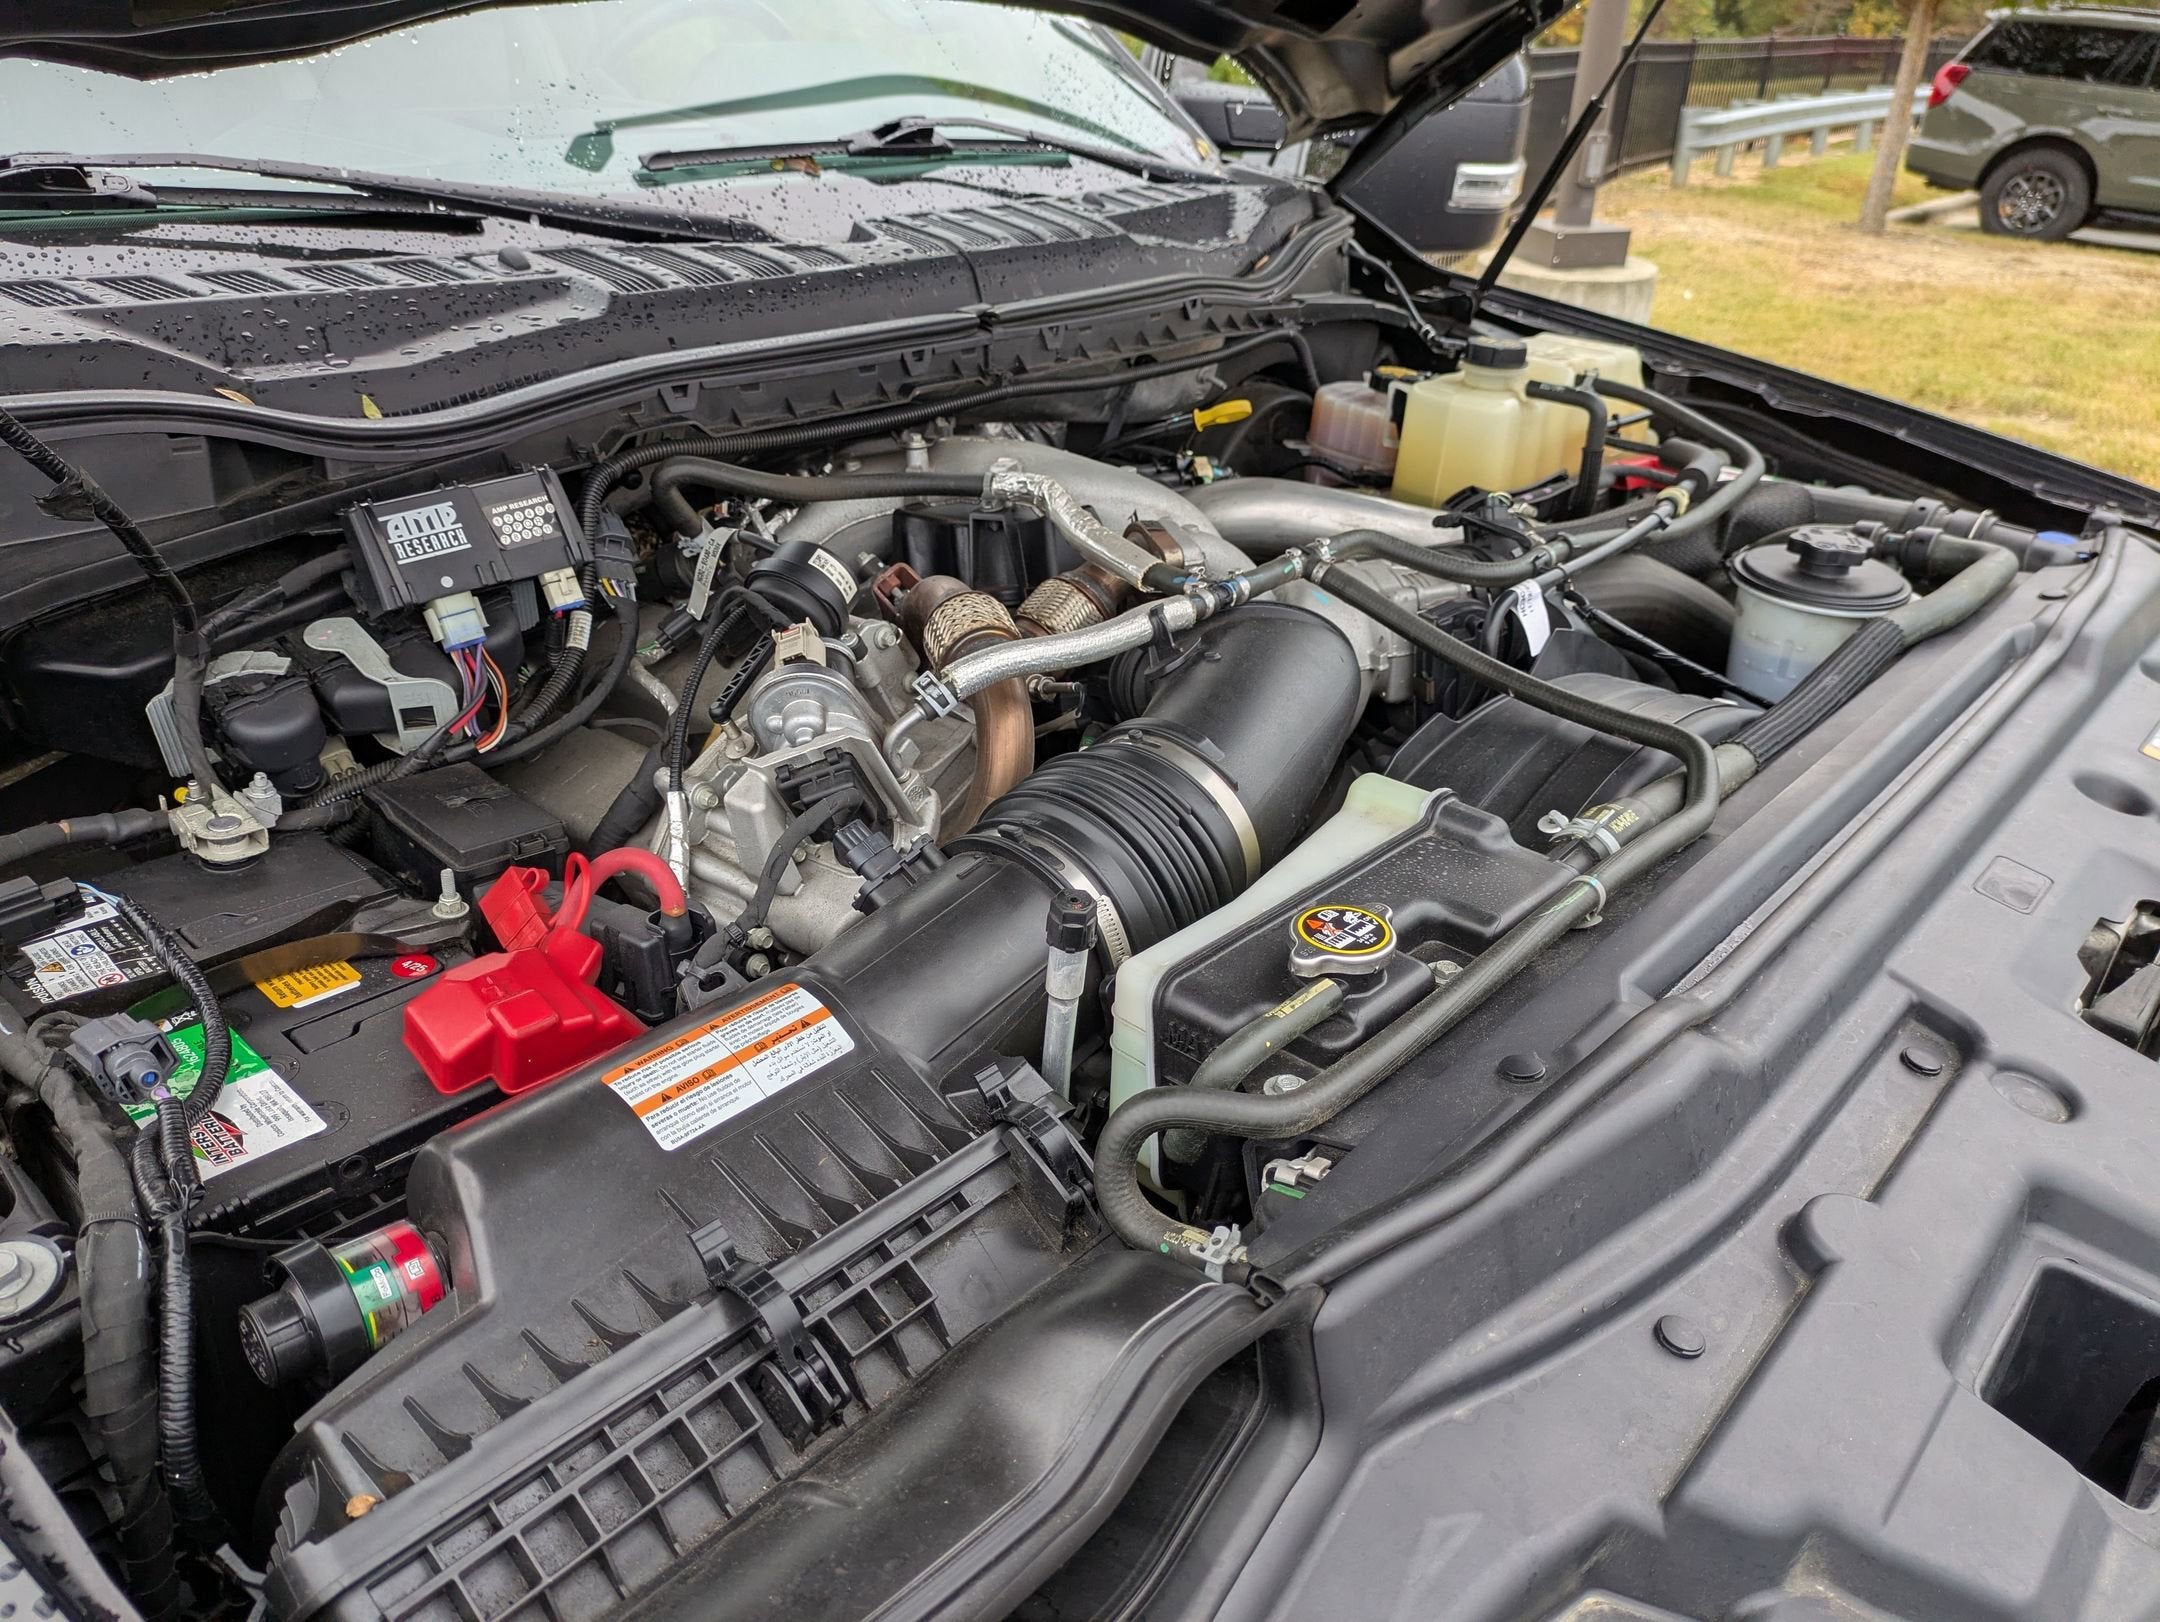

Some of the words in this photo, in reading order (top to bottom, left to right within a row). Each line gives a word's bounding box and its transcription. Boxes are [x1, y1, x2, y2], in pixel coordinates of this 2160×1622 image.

[492, 504, 508, 514] AMP
[508, 496, 548, 510] RESEARCH
[382, 503, 459, 541] AMP
[394, 529, 467, 560] RESEARCH
[400, 960, 428, 972] 4/25
[721, 992, 778, 1022] AVERTISSEMENT
[171, 1037, 199, 1066] 1624805
[621, 1071, 641, 1082] reduce
[658, 1051, 681, 1064] possible
[681, 1041, 701, 1052] serious
[635, 1045, 673, 1065] WARNING
[618, 1081, 635, 1090] injury
[686, 1046, 701, 1056] starter
[623, 1086, 639, 1095] (such
[646, 1074, 662, 1083] ether)
[629, 1090, 644, 1100] assist
[645, 1112, 659, 1121] Para
[659, 1101, 679, 1114] reducir
[685, 1089, 703, 1100] riesgo
[710, 1073, 732, 1087] lesiones
[676, 1076, 699, 1093] AVISO
[253, 1106, 272, 1125] Wholesale
[651, 1114, 672, 1128] severas
[677, 1100, 698, 1113] muerte:
[706, 1090, 717, 1098] use
[716, 1081, 733, 1092] fluidos
[655, 1119, 679, 1134] arranque
[678, 1110, 695, 1122] (como
[695, 1103, 708, 1112] éter)
[713, 1090, 732, 1103] arranca
[737, 1079, 751, 1090] motor
[660, 1133, 671, 1141] con
[689, 1112, 709, 1125] caliente
